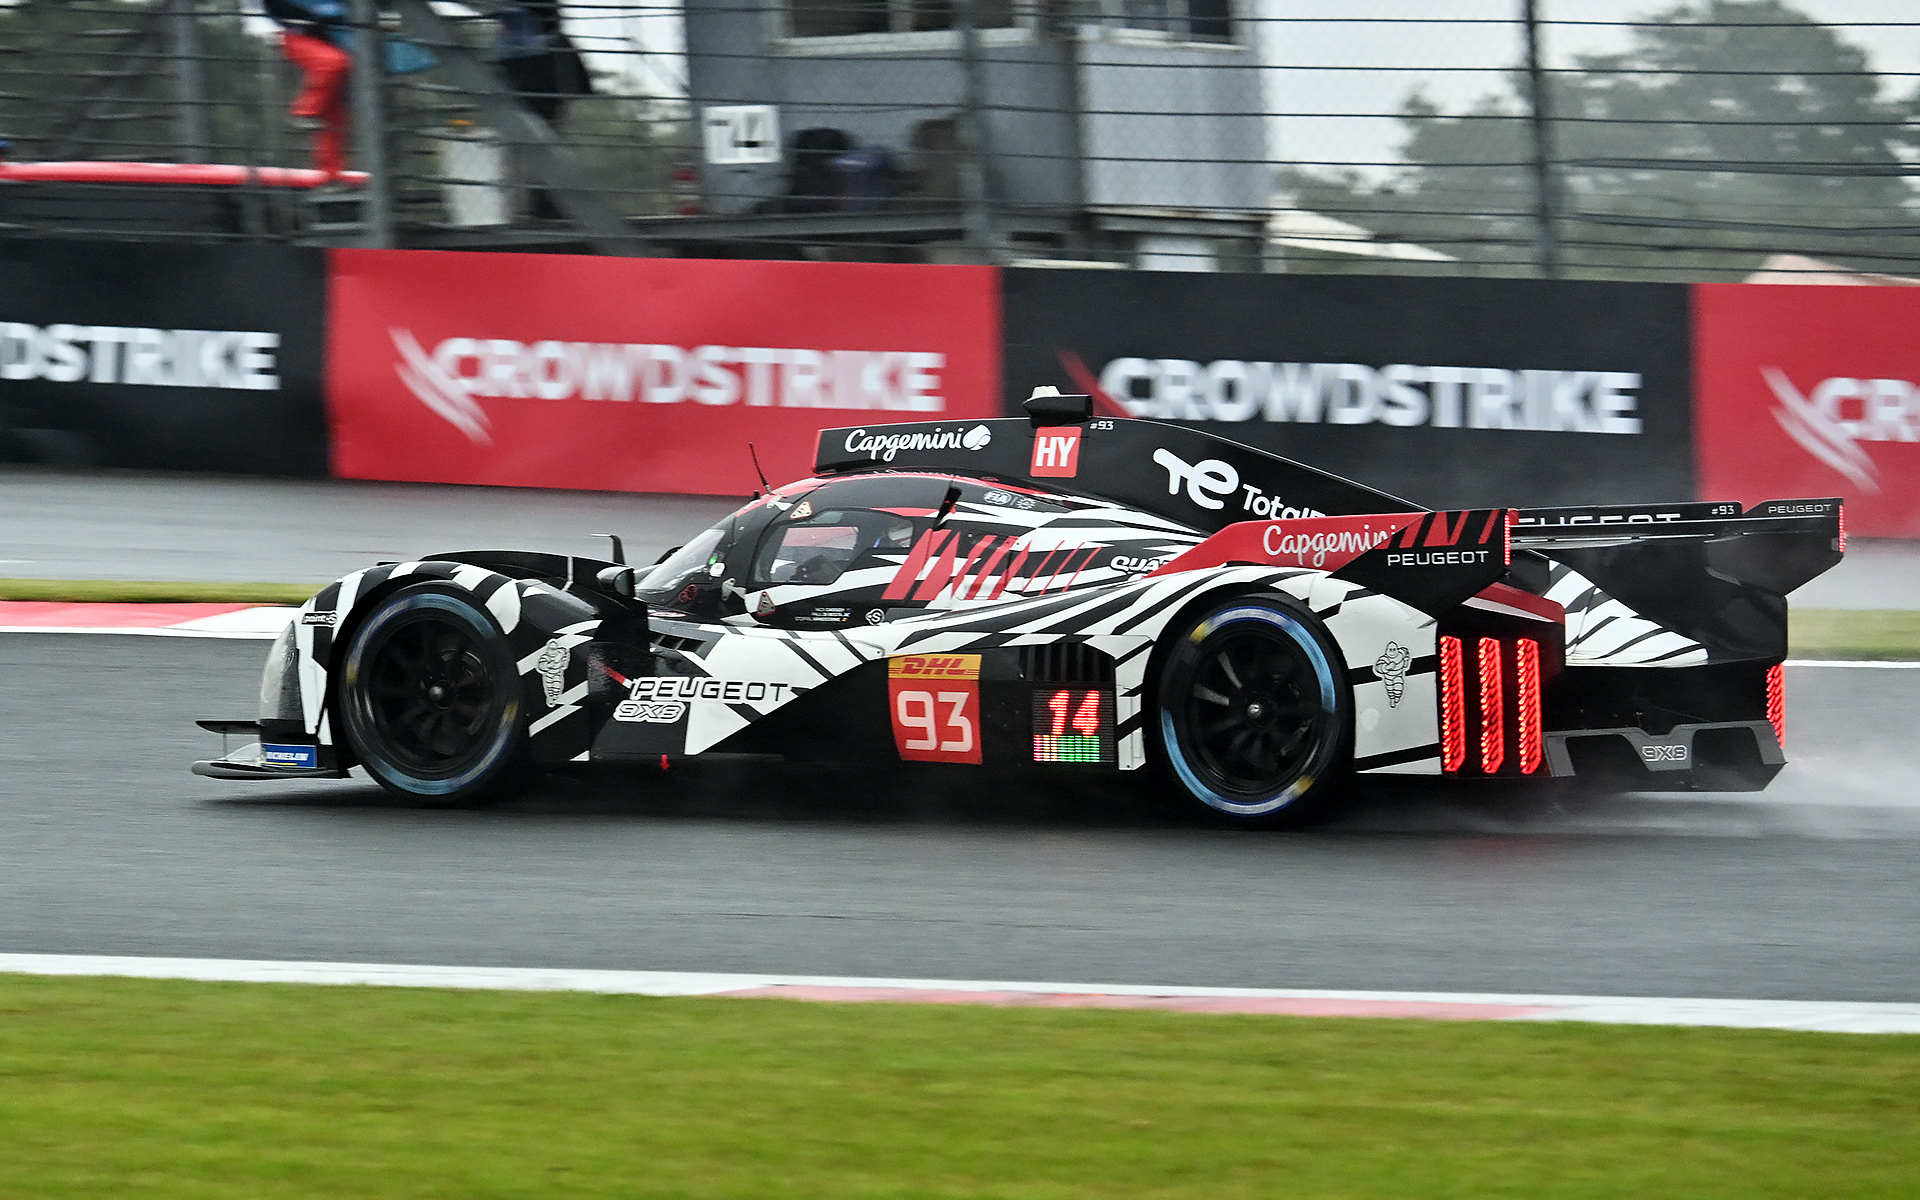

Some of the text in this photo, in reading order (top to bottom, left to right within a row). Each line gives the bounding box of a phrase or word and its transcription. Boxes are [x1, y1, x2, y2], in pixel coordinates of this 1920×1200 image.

[435, 338, 944, 411] CROWDSTRIKE
[1101, 357, 1641, 434] CROWDSTRIKE
[1090, 421, 1114, 430] #93
[845, 427, 964, 461] Capgemini
[1035, 436, 1077, 468] HY
[1711, 505, 1735, 515] #93
[1768, 504, 1832, 514] PEUGEOT
[1110, 555, 1170, 573] QUA
[1387, 551, 1489, 567] PEUGEOT
[900, 657, 967, 675] DHL
[631, 679, 789, 702] PEUGEOT
[615, 701, 686, 721] 9X8
[897, 690, 973, 752] 93
[1048, 690, 1101, 736] 14
[1642, 744, 1688, 761] 9X8
